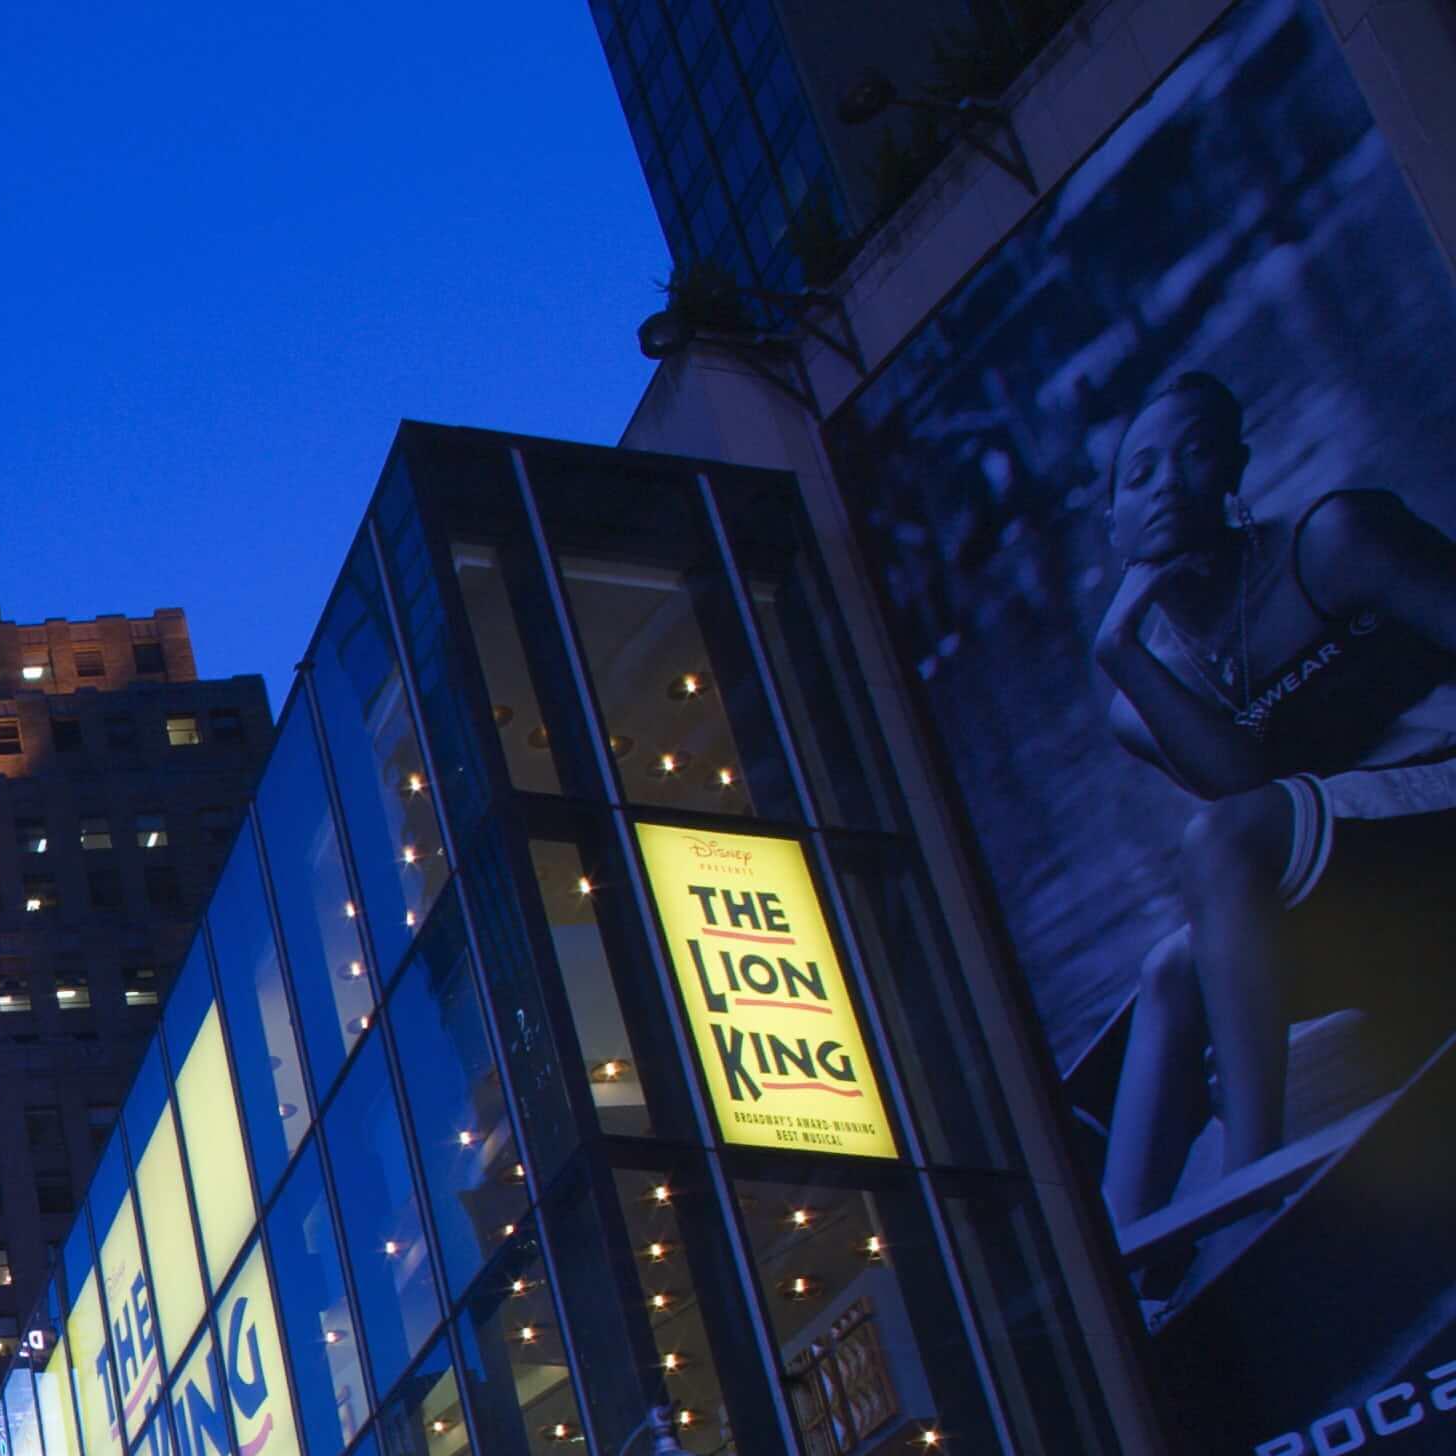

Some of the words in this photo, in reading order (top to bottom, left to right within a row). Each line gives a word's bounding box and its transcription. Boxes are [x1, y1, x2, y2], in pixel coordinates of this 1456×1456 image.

[688, 885, 790, 933] THE
[687, 939, 828, 1014] LION
[710, 1023, 857, 1102] KING
[734, 1111, 793, 1128] BROADWAY'S
[776, 1129, 799, 1142] BEST
[802, 1132, 843, 1146] MUSICAL
[96, 1270, 154, 1426] THE
